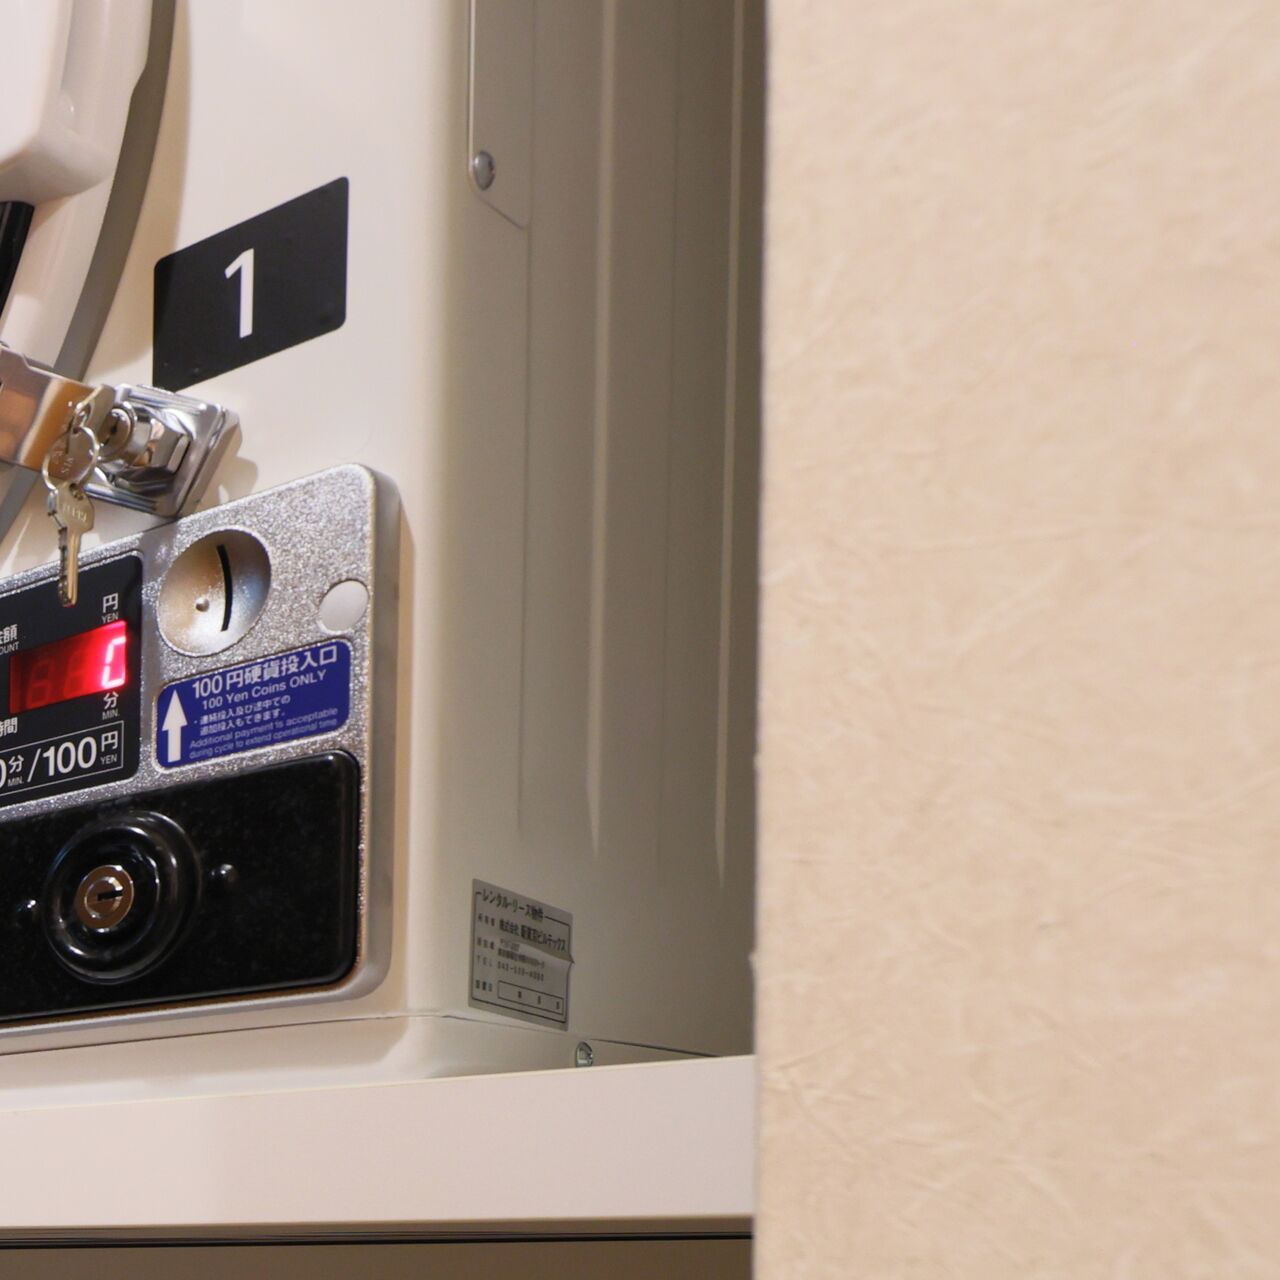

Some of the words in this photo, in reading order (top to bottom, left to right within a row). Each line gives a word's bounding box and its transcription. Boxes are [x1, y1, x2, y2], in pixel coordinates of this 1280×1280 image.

[224, 248, 255, 338] 1
[102, 593, 119, 614] 円
[102, 612, 119, 624] YEN
[192, 645, 337, 699] 100円硬貨投入口
[203, 698, 223, 710] 100
[226, 691, 248, 705] Yen
[251, 681, 286, 698] Coins
[289, 669, 326, 688] ONLY
[103, 691, 119, 710] 分
[102, 708, 120, 721] MIN.
[100, 753, 117, 765] YEN
